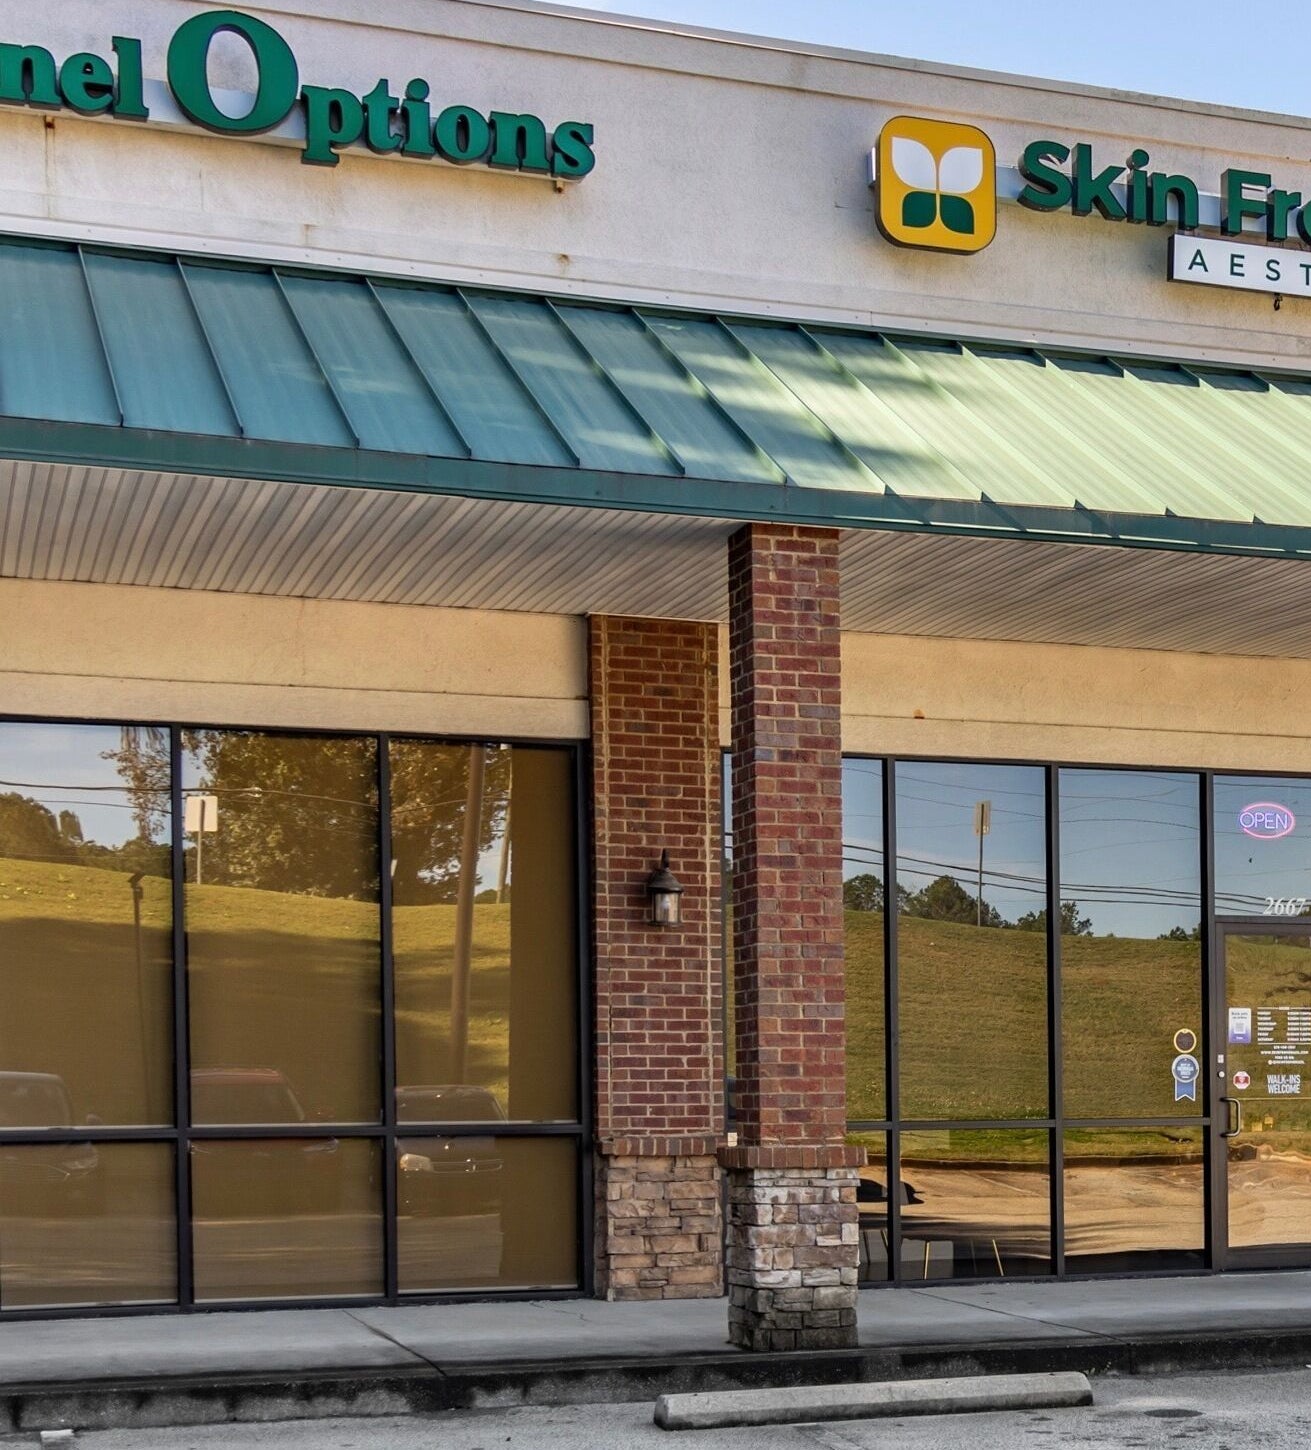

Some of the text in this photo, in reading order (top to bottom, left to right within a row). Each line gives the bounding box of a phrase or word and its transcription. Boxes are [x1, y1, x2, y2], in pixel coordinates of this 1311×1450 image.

[167, 10, 595, 180] Options
[1017, 140, 1198, 230] Skin
[1239, 812, 1289, 830] OPEN
[1263, 897, 1307, 917] 2667
[1267, 1074, 1300, 1084] WALK-INS
[1267, 1084, 1300, 1094] WELCOME
